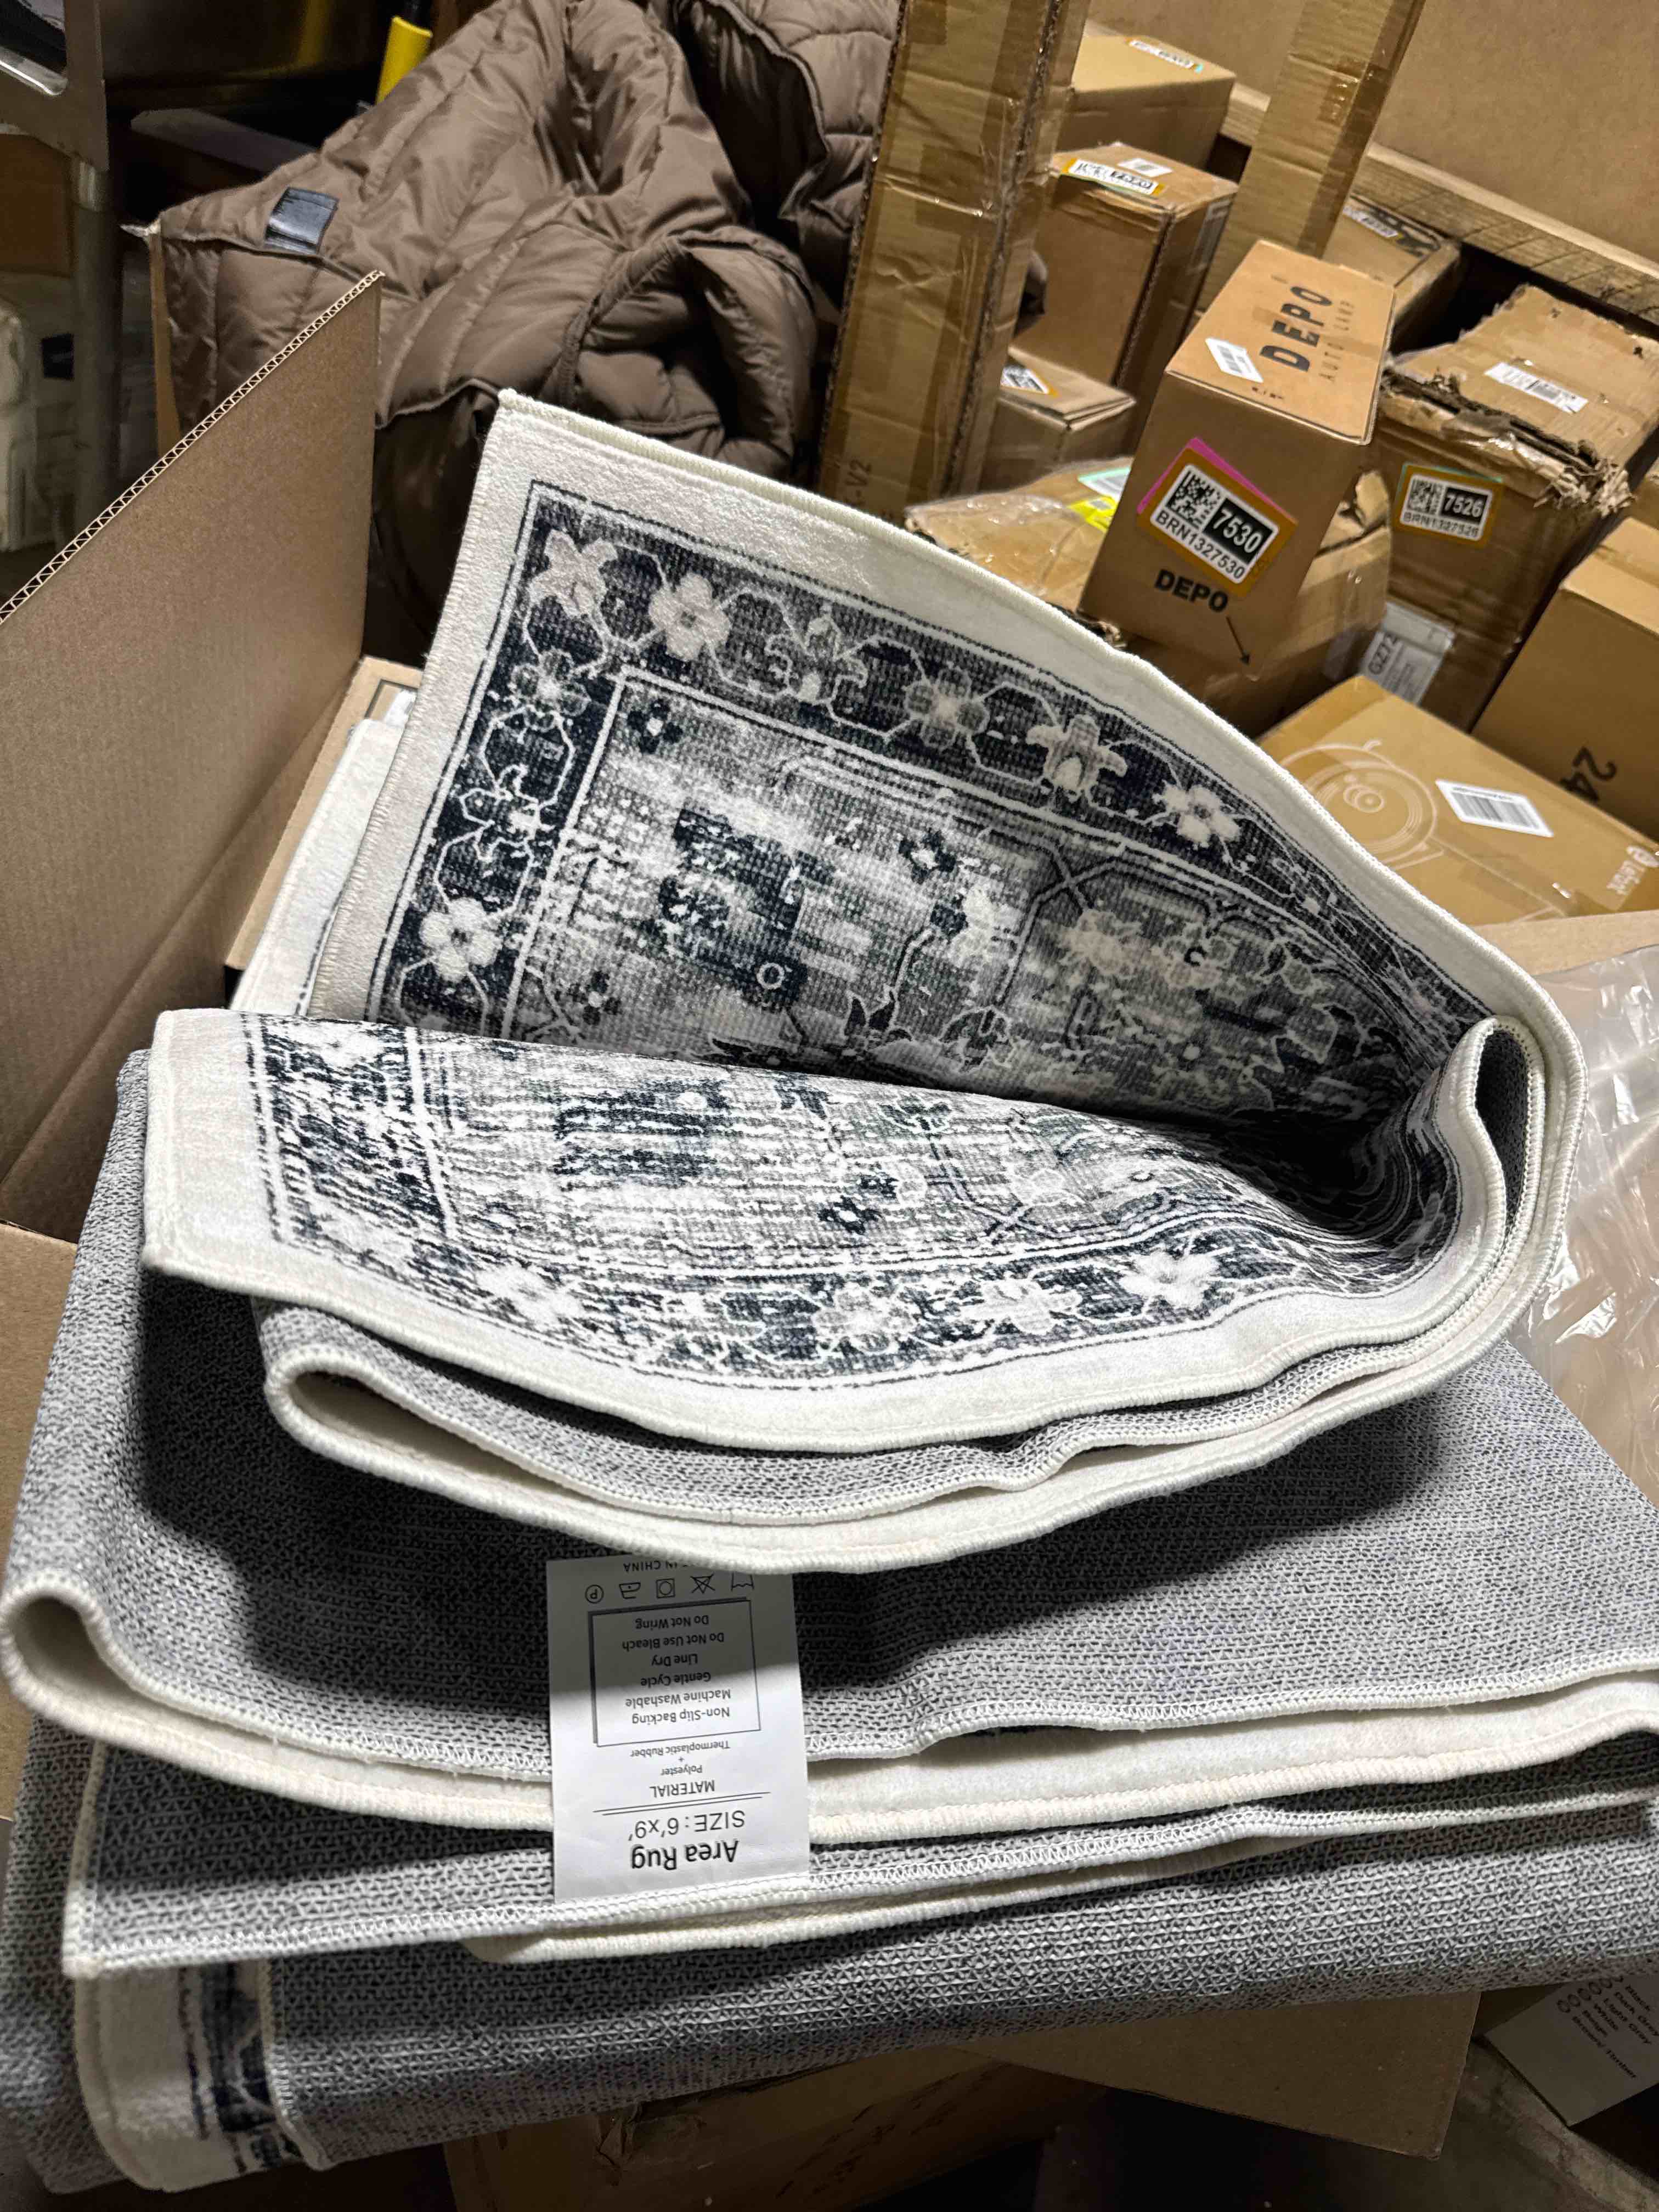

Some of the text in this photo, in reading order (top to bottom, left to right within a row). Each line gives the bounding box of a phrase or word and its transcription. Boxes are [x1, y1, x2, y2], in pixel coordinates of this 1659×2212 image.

[1260, 286, 1333, 373] DEPO
[1444, 494, 1485, 518] 7526
[1212, 507, 1262, 554] 7530
[1155, 510, 1245, 579] BRN1327530
[1154, 568, 1228, 613] DEPO
[623, 1560, 662, 1572] CHINA
[635, 1615, 709, 1630] Do Not Wring
[622, 1632, 725, 1651] Do Not Use Bleach
[651, 1654, 698, 1667] Line Dry
[641, 1672, 712, 1688] Gentle Cycle
[625, 1689, 731, 1709] Machine Washable
[632, 1707, 730, 1725] Non-Slip Backing
[630, 1740, 731, 1757] Thermoplastic Rubber
[661, 1764, 703, 1776] Polyester
[650, 1780, 715, 1798] MATERIAL
[630, 1838, 739, 1871] Area Rug
